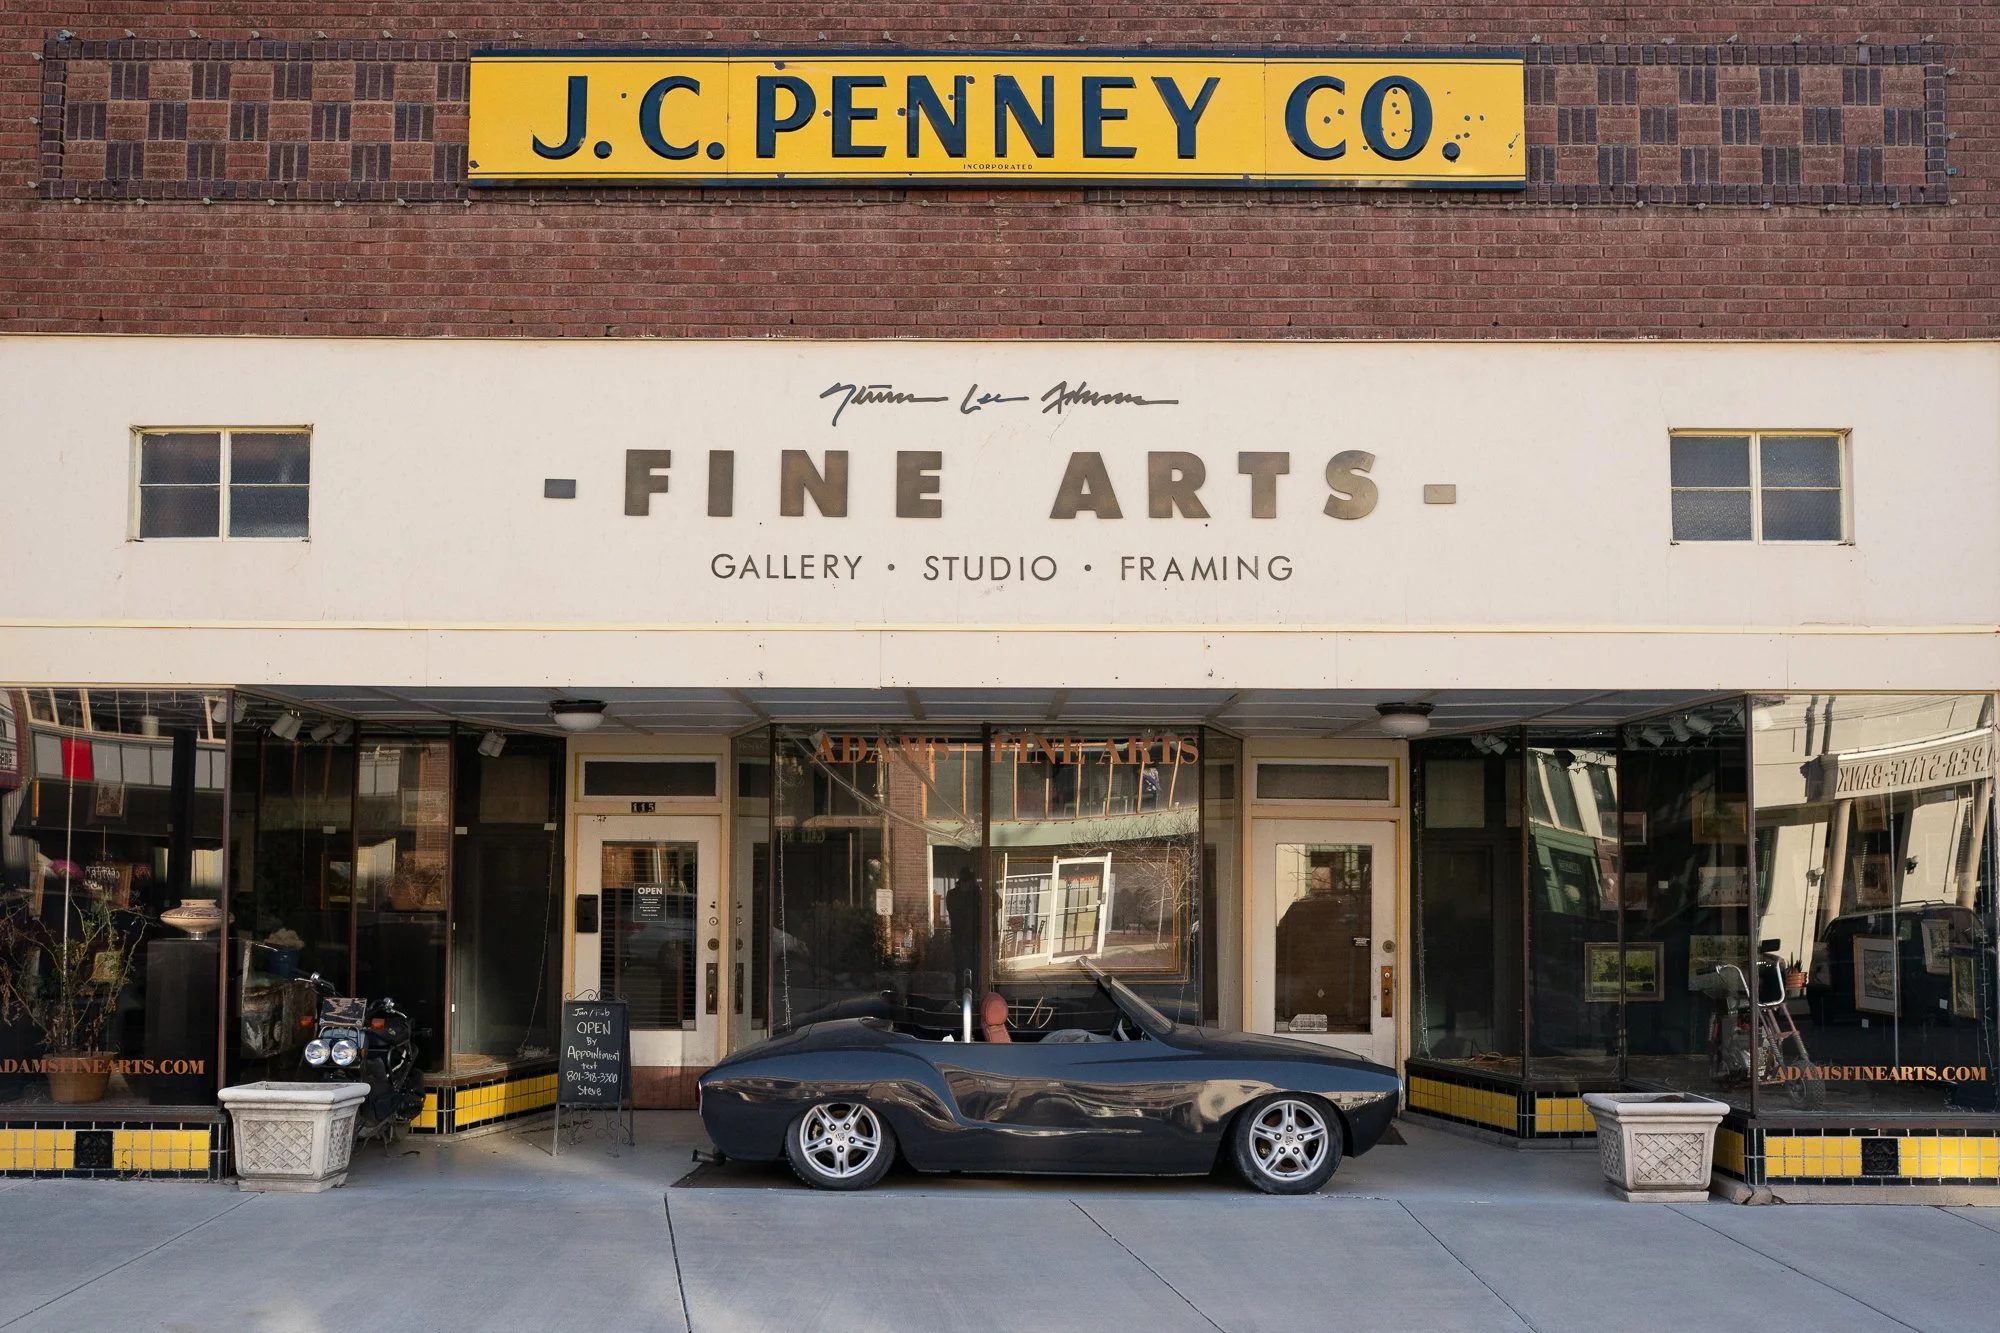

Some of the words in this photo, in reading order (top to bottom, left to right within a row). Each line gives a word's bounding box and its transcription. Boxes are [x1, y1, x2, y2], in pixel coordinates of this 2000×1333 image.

[756, 75, 1221, 160] PENNEY
[1285, 75, 1460, 162] CO.
[625, 449, 942, 519] FINE
[1049, 450, 1377, 521] ARTS
[711, 553, 863, 582] GALLERY
[923, 555, 1058, 582] STUDIO
[1121, 555, 1294, 582] FRAMING
[811, 735, 950, 764] ADAMS
[990, 735, 1086, 765] FINE
[1096, 735, 1200, 765] ARTS
[632, 803, 654, 812] 115
[637, 887, 663, 895] OPEN
[577, 1021, 611, 1035] OPEN
[1775, 1066, 1987, 1081] ADAMSFINEARTS.COM
[578, 1085, 602, 1096] Steve
